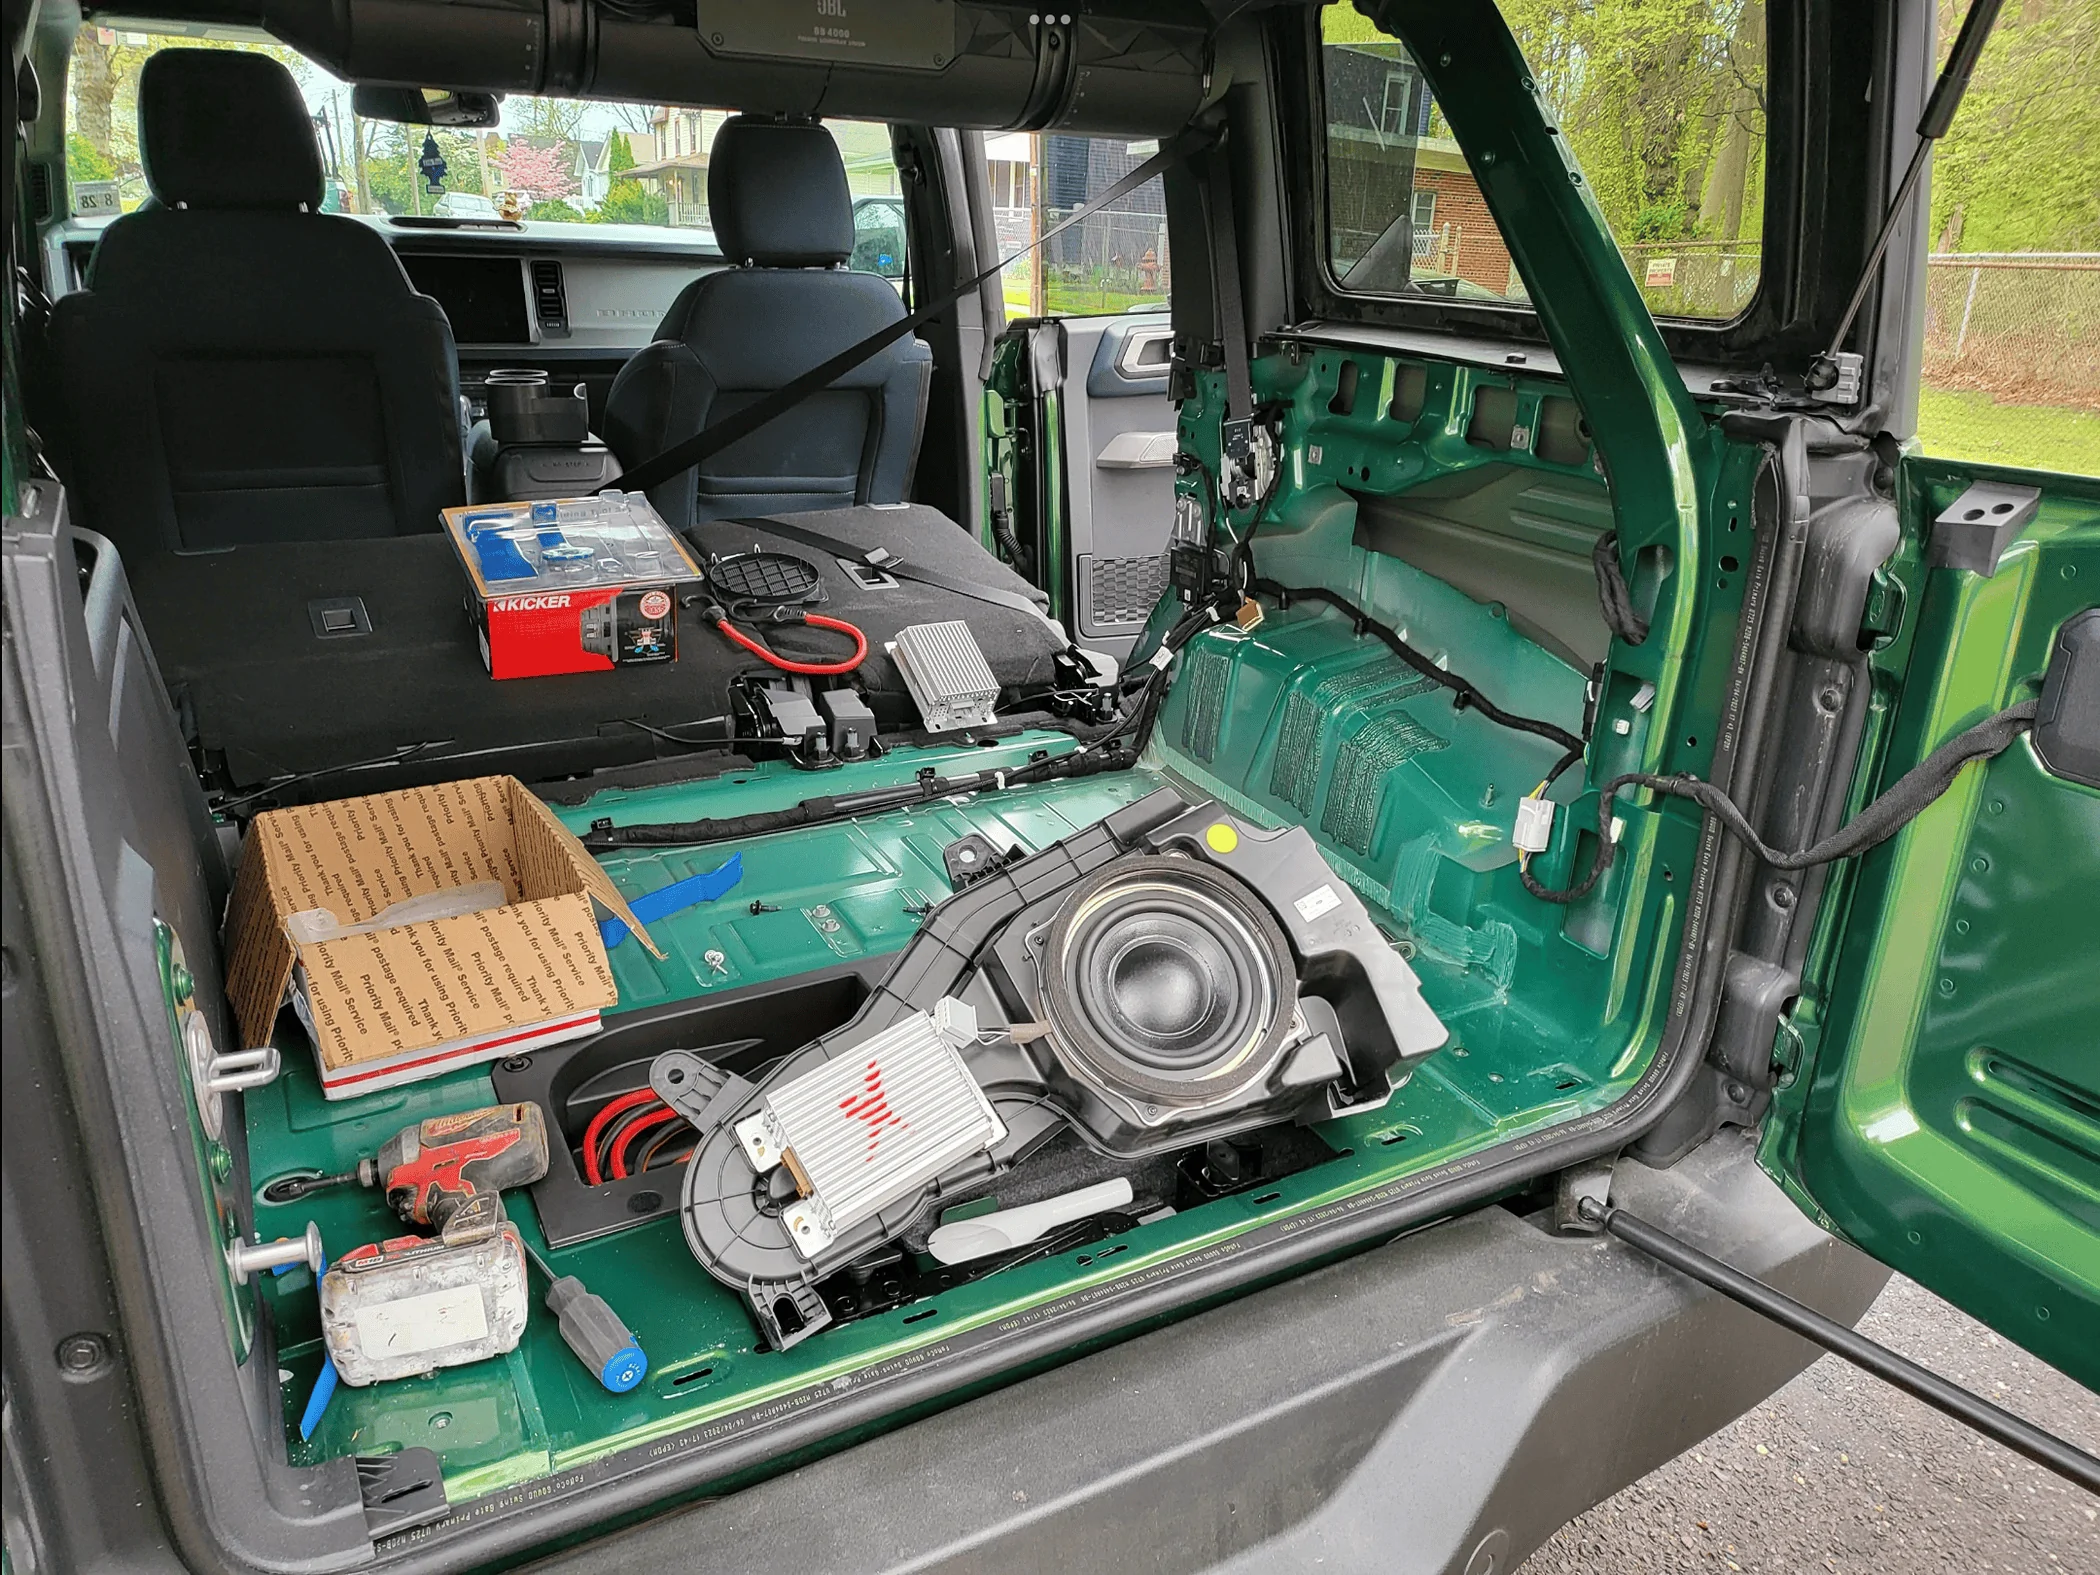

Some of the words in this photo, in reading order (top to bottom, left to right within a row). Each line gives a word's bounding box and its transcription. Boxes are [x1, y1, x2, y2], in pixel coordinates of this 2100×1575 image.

[507, 595, 571, 611] KICKER
[383, 797, 401, 822] using
[433, 791, 455, 824] Priority
[267, 809, 284, 840] Servic
[291, 813, 308, 839] using
[344, 807, 367, 841] Priority
[393, 821, 405, 836] for
[423, 813, 445, 848] postage
[301, 838, 313, 853] for
[333, 829, 356, 865] postage
[400, 835, 414, 853] you
[468, 828, 490, 859] Priority
[309, 852, 322, 869] you
[382, 843, 404, 876] Priority
[407, 852, 425, 878] Thank
[421, 854, 443, 889] required
[459, 850, 479, 880] Service
[499, 847, 519, 876] Service
[290, 861, 311, 893] Priority
[316, 869, 334, 896] Thank
[331, 871, 354, 907] required
[372, 867, 392, 898] Service
[397, 875, 413, 898] using
[410, 937, 427, 958] you
[517, 918, 532, 937] you
[529, 936, 543, 952] for
[536, 951, 556, 979] using
[573, 930, 598, 965] Priority
[421, 956, 436, 974] for
[469, 950, 496, 988] Priority
[479, 923, 508, 964] postage
[500, 961, 530, 1004] required
[561, 951, 586, 987] Service
[307, 979, 323, 998] for
[358, 972, 386, 1012] Priority
[370, 944, 399, 985] postage
[390, 984, 421, 1028] required
[428, 973, 450, 1002] using
[456, 972, 482, 1010] Service
[525, 974, 548, 1005] Thank
[313, 997, 336, 1027] using
[342, 995, 370, 1035] Service
[416, 997, 440, 1030] Thank
